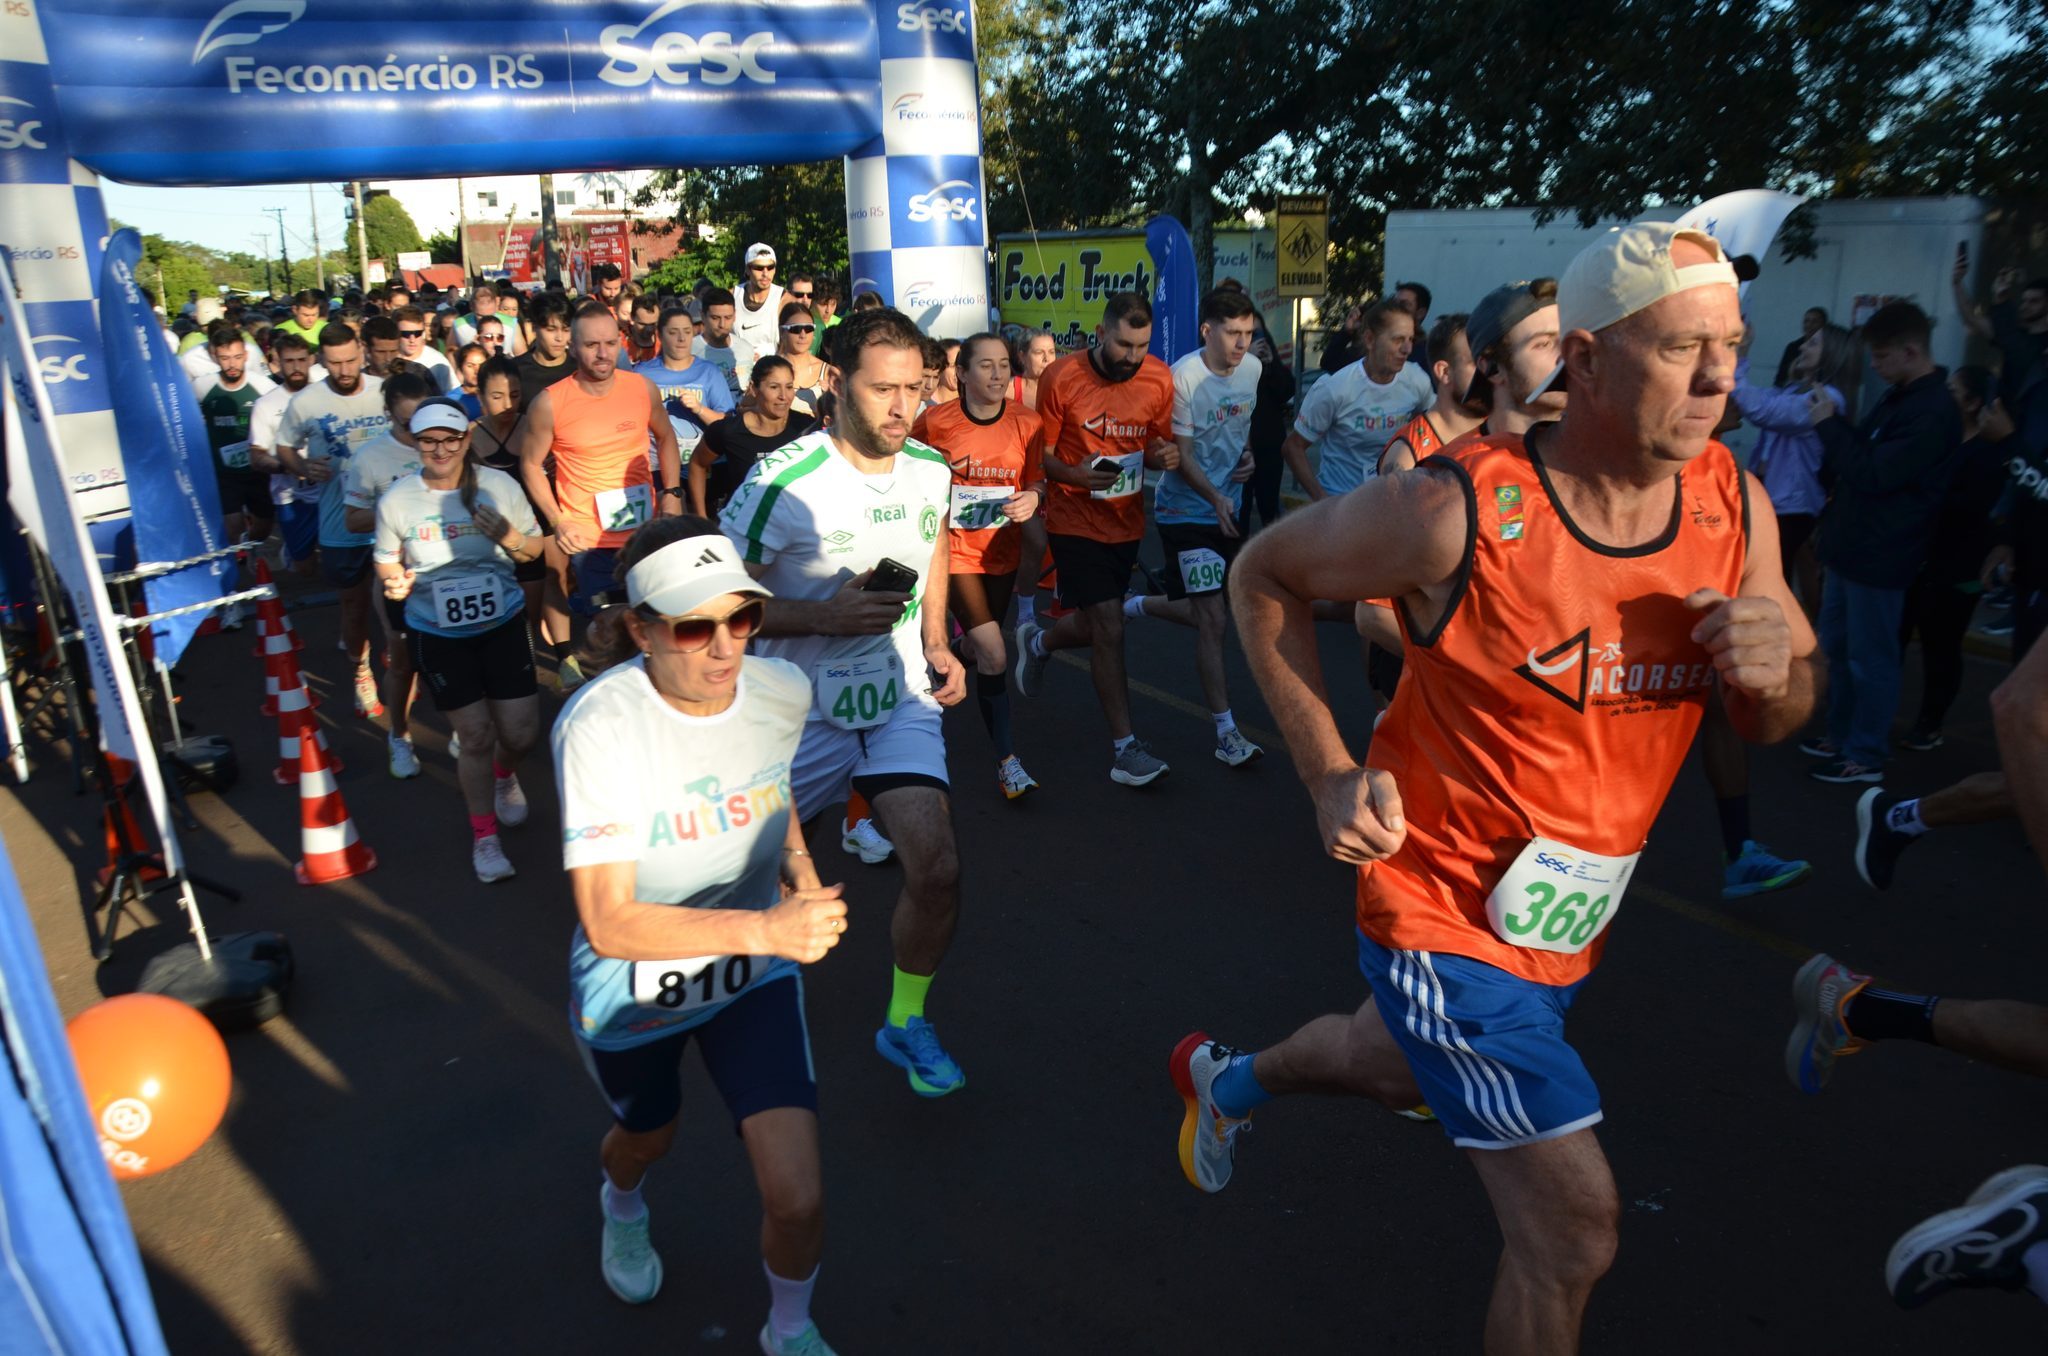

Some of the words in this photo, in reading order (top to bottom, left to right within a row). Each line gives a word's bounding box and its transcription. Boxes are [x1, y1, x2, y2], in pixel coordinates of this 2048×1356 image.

[897, 3, 967, 35] Sesc
[597, 24, 776, 87] Sesc
[225, 54, 477, 93] Fecomércio
[489, 54, 545, 89] RS
[967, 111, 977, 122] RS
[870, 206, 884, 217] RS
[907, 194, 977, 223] Sesc
[57, 246, 79, 260] RS
[1003, 250, 1067, 301] Food
[1079, 249, 1152, 302] Truck
[1281, 272, 1322, 286] ELEVADA
[910, 292, 976, 307] Fecomércio
[100, 467, 120, 481] RS
[726, 440, 804, 521] HAVAN
[872, 504, 906, 524] Real
[958, 502, 1005, 525] 476
[1188, 562, 1224, 588] 496
[446, 591, 496, 624] 855
[827, 669, 851, 678] Sesc
[832, 678, 897, 723] 404
[1535, 852, 1573, 875] Sesc
[1505, 881, 1610, 946] 368
[655, 954, 752, 1008] 810
